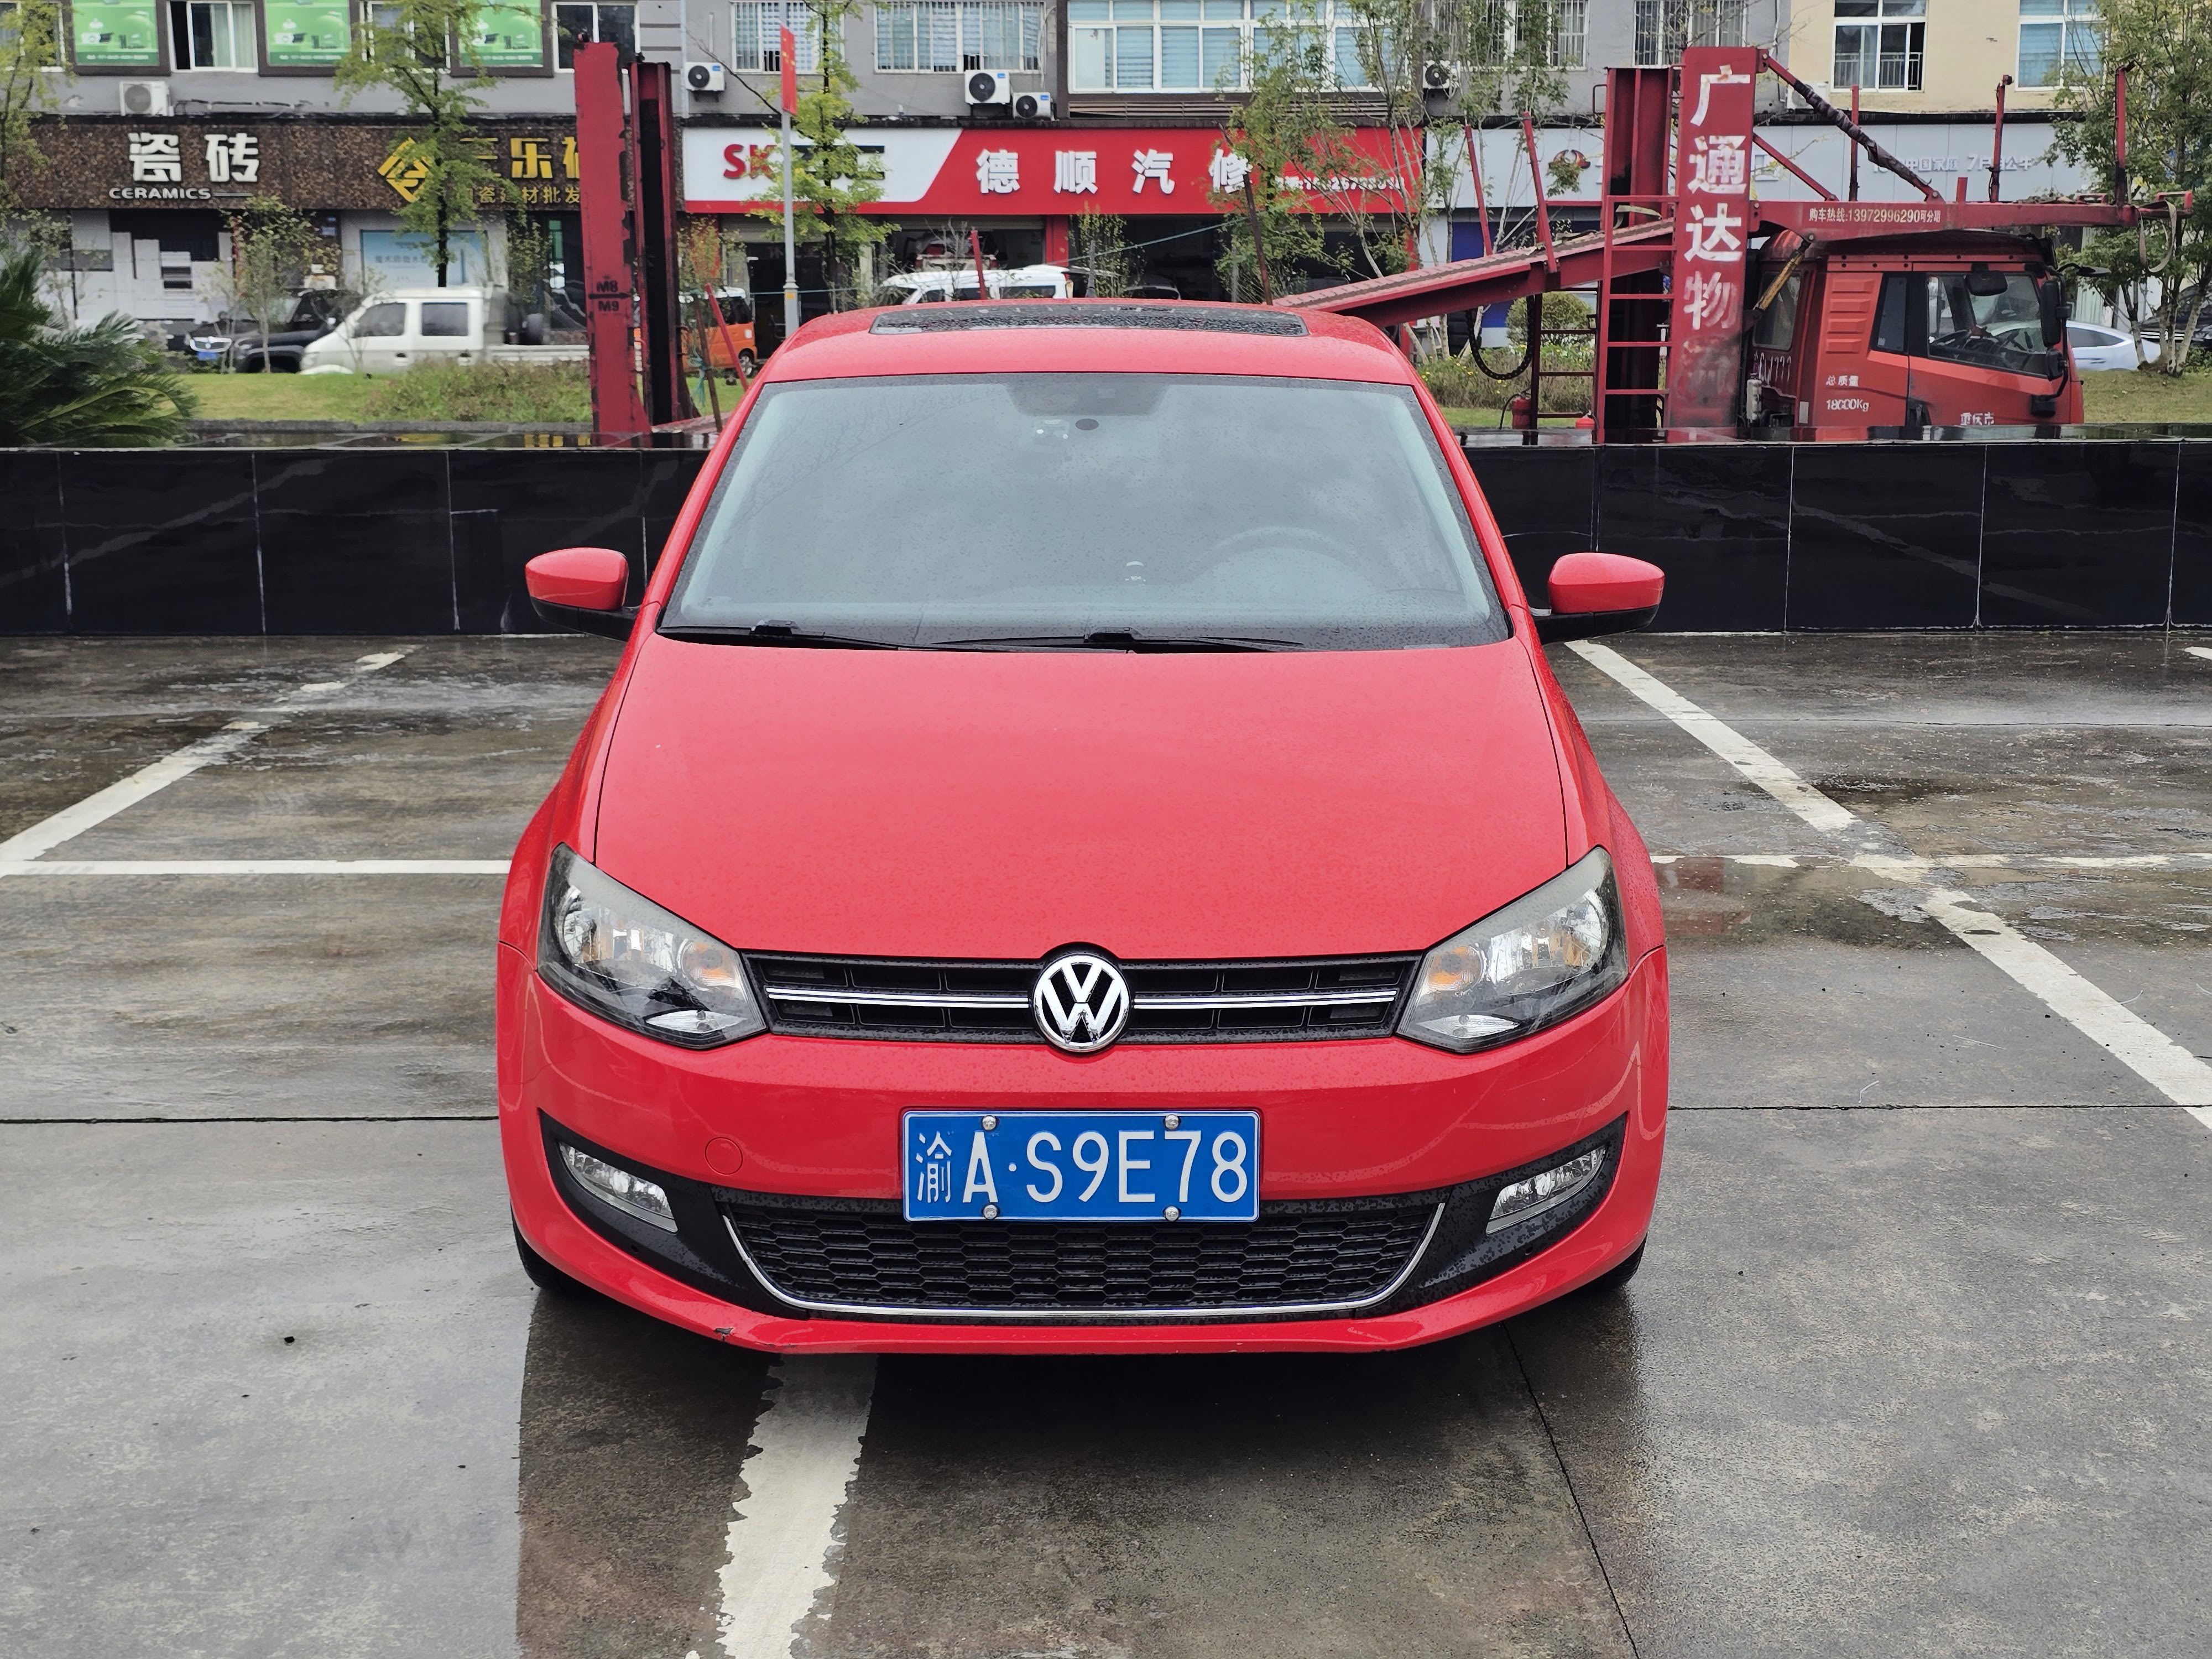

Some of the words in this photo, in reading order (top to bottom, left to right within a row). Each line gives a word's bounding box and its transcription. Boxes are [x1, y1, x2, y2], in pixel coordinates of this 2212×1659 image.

[128, 132, 260, 182] 瓷砖
[976, 149, 1252, 195] 德顺汽修
[109, 187, 211, 200] CERAMICS
[596, 280, 618, 293] M8
[598, 300, 619, 312] M9
[1826, 375, 1859, 387] 总质量
